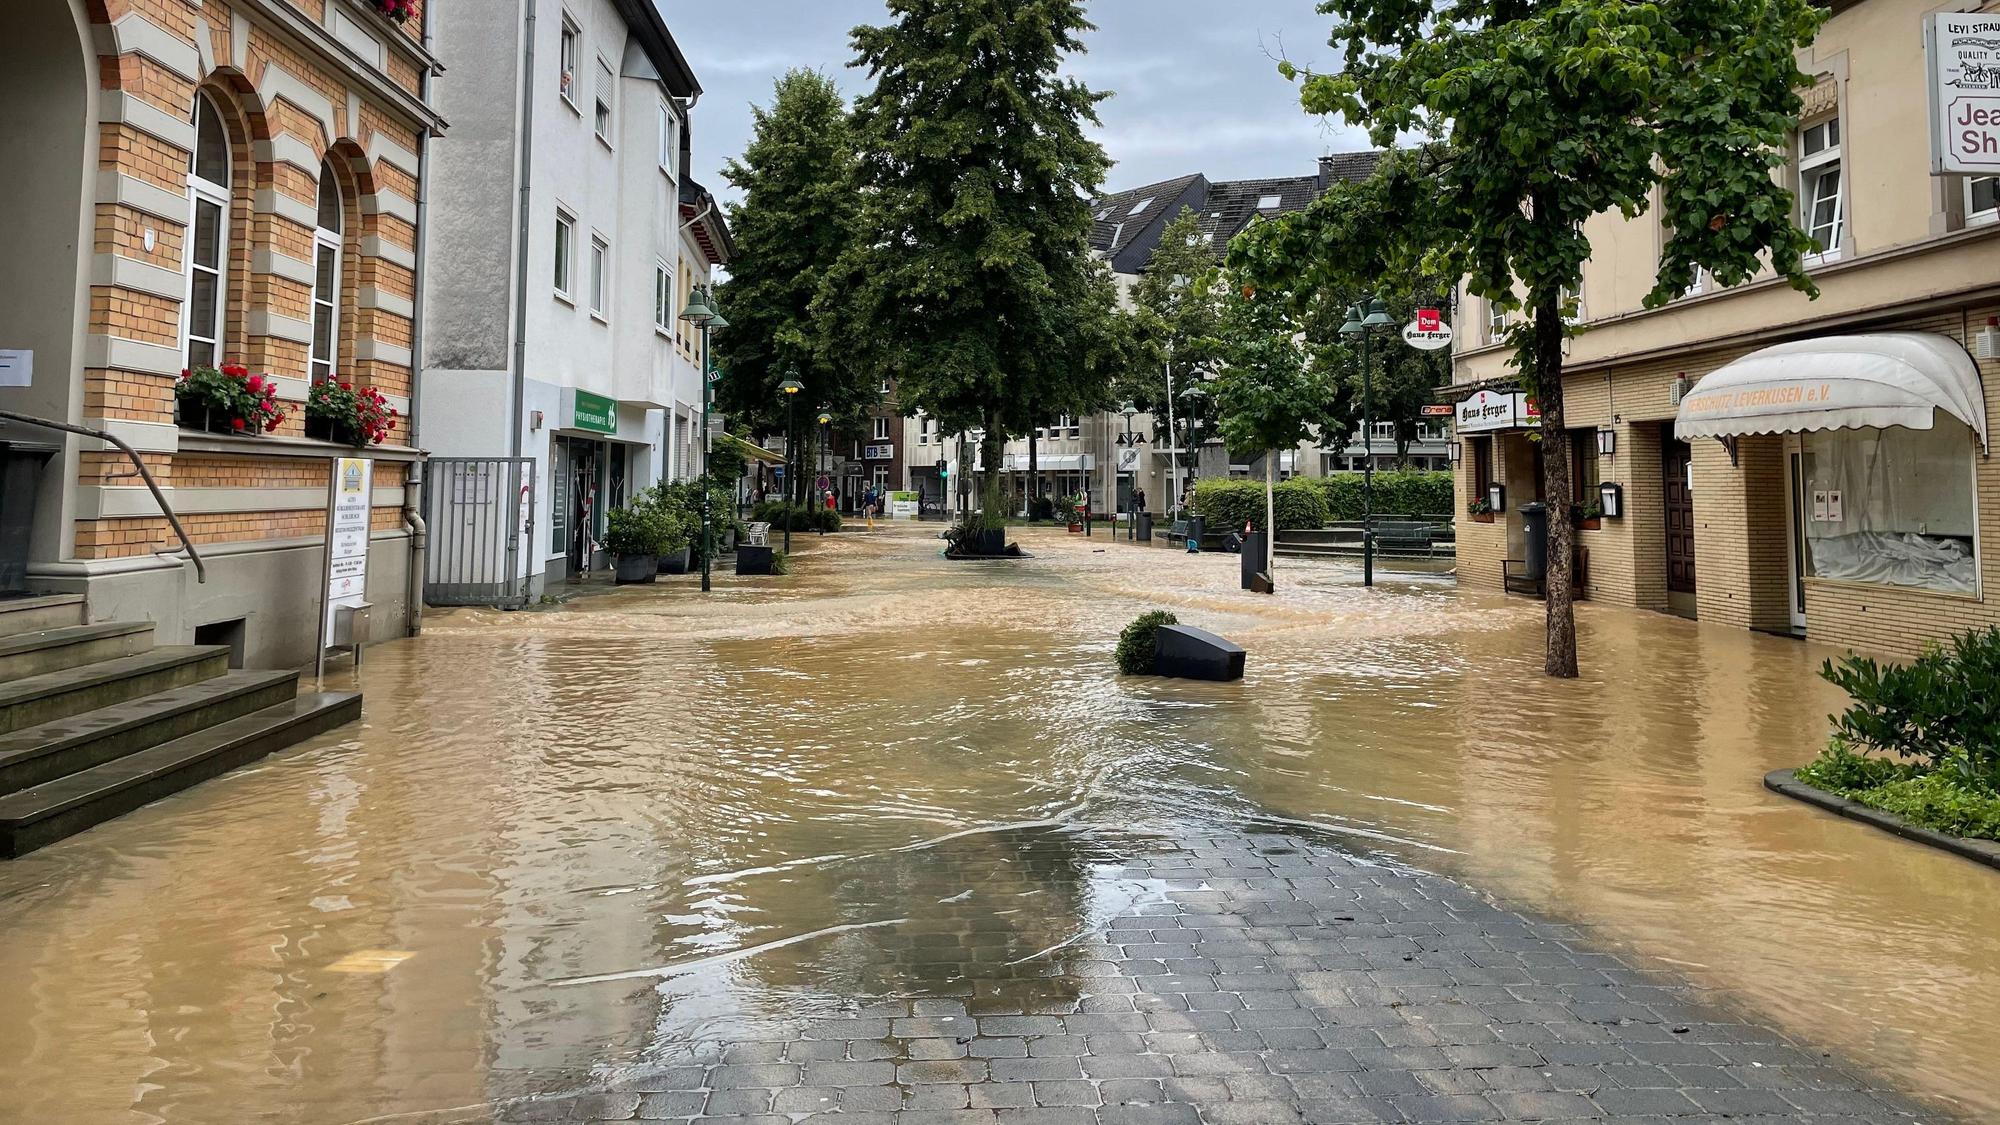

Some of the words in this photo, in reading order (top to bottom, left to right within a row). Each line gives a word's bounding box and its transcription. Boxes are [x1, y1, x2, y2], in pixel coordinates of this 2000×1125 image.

[1948, 23, 1969, 34] LEVI
[1958, 50, 1987, 60] QUALITY
[1957, 103, 2000, 126] Jea
[1961, 130, 1998, 154] Sh
[1421, 317, 1437, 325] Dom
[1406, 331, 1425, 340] Haus
[1427, 331, 1451, 340] Ferger
[1733, 385, 1804, 408] LEVERKUSEN
[576, 410, 606, 426] PHYSIOTHERAPIE
[1462, 407, 1480, 421] Haus
[1482, 404, 1507, 419] Ferger
[866, 447, 878, 458] BTB
